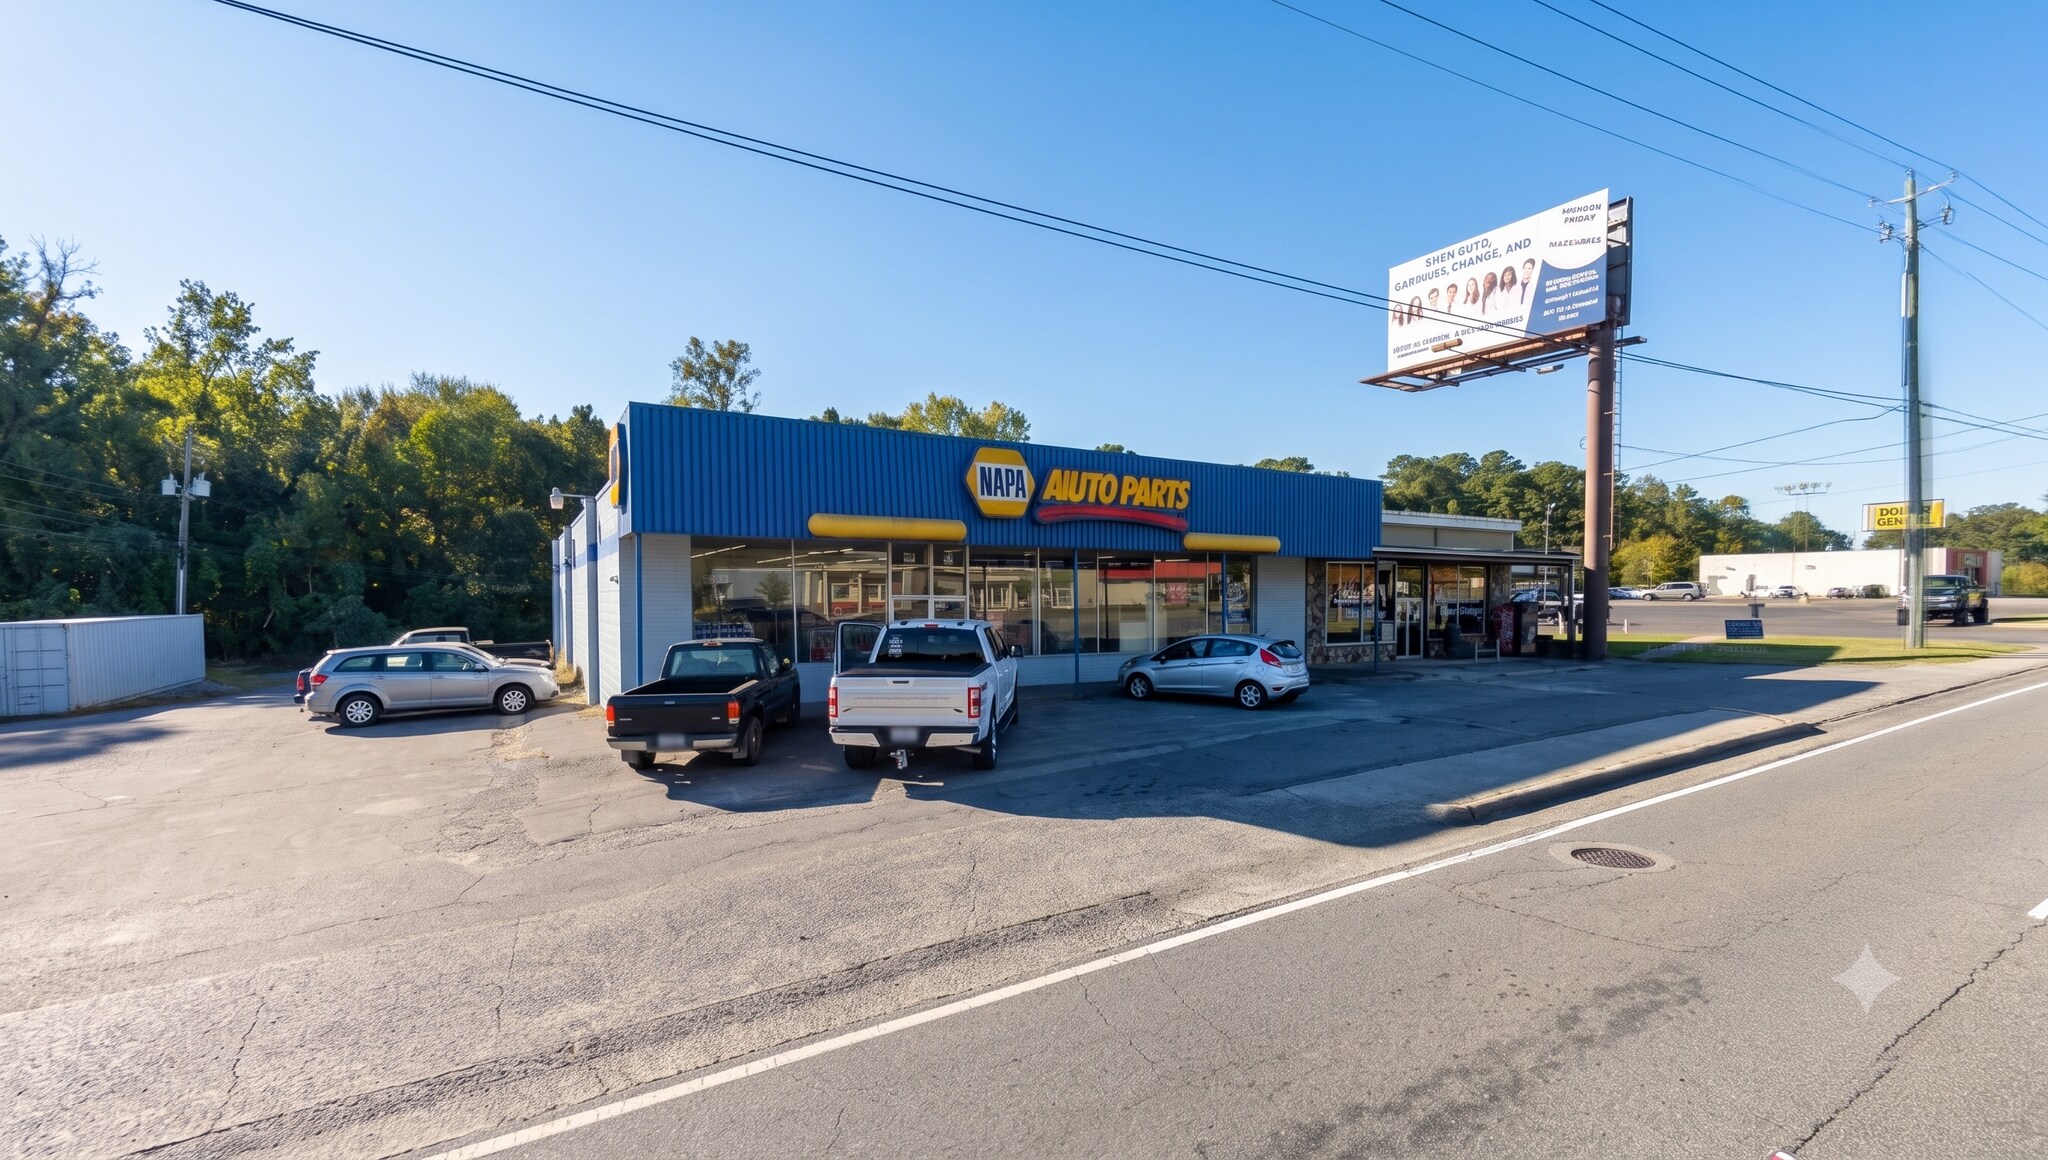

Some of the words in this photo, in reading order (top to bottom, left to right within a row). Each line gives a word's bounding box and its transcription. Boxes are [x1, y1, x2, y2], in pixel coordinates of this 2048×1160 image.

[1425, 250, 1456, 268] SHEN
[1451, 248, 1502, 272] CHANGE,
[1505, 238, 1532, 255] AND
[979, 466, 1027, 499] NAPA
[1119, 475, 1191, 510] PARTS
